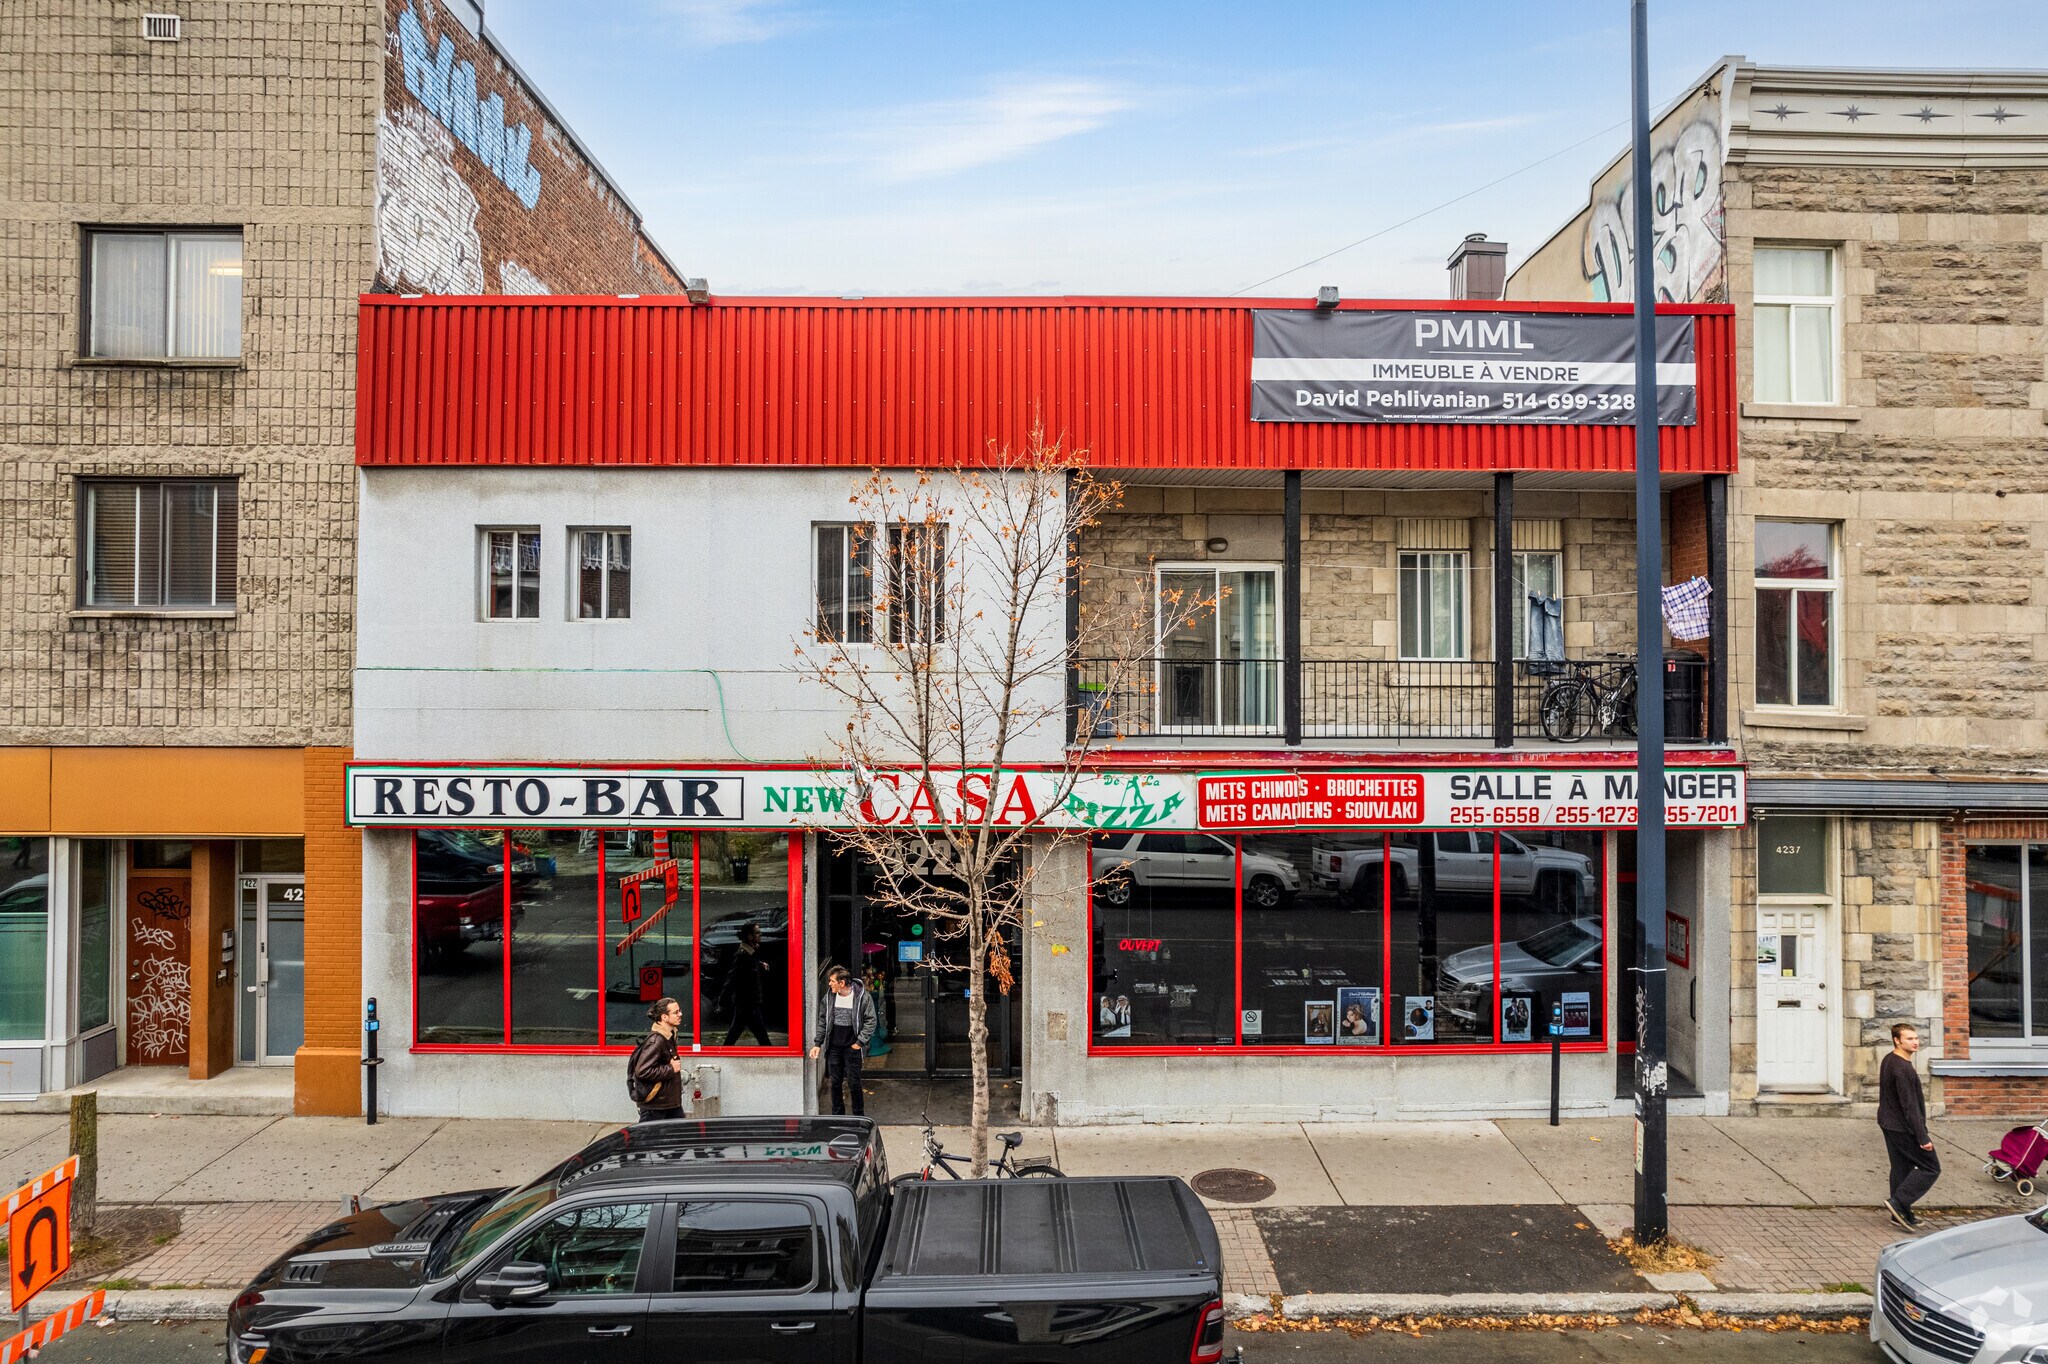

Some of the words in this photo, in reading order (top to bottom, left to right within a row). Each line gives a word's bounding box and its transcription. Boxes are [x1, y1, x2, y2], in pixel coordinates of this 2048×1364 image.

[1415, 318, 1535, 350] PMML
[1372, 363, 1474, 380] IMMEUBLE
[1480, 360, 1494, 381] À
[1499, 365, 1579, 382] VENDRE
[1296, 389, 1359, 407] David
[1366, 389, 1490, 408] Pehlivanian
[1502, 391, 1636, 411] 514-699-328
[1103, 775, 1120, 786] De
[1145, 775, 1160, 786] La
[1205, 782, 1246, 800] METS
[1251, 779, 1309, 798] CHINOIS
[1326, 779, 1417, 797] BROCHETTES
[1450, 774, 1552, 800] SALLE
[1604, 774, 1737, 800] MNGER
[374, 777, 725, 818] RESTO-BAR
[763, 786, 848, 814] NEW
[859, 773, 1045, 826] CASA
[1062, 791, 1187, 828] PIZZA
[1206, 804, 1247, 822] METS
[1252, 801, 1332, 821] CANADIENS
[1345, 801, 1417, 819] SOUVLAKI
[1450, 806, 1540, 824] 255-6558
[1556, 806, 1639, 823] 255-1273
[1663, 805, 1737, 823] 55-7201
[1776, 845, 1801, 854] 4237
